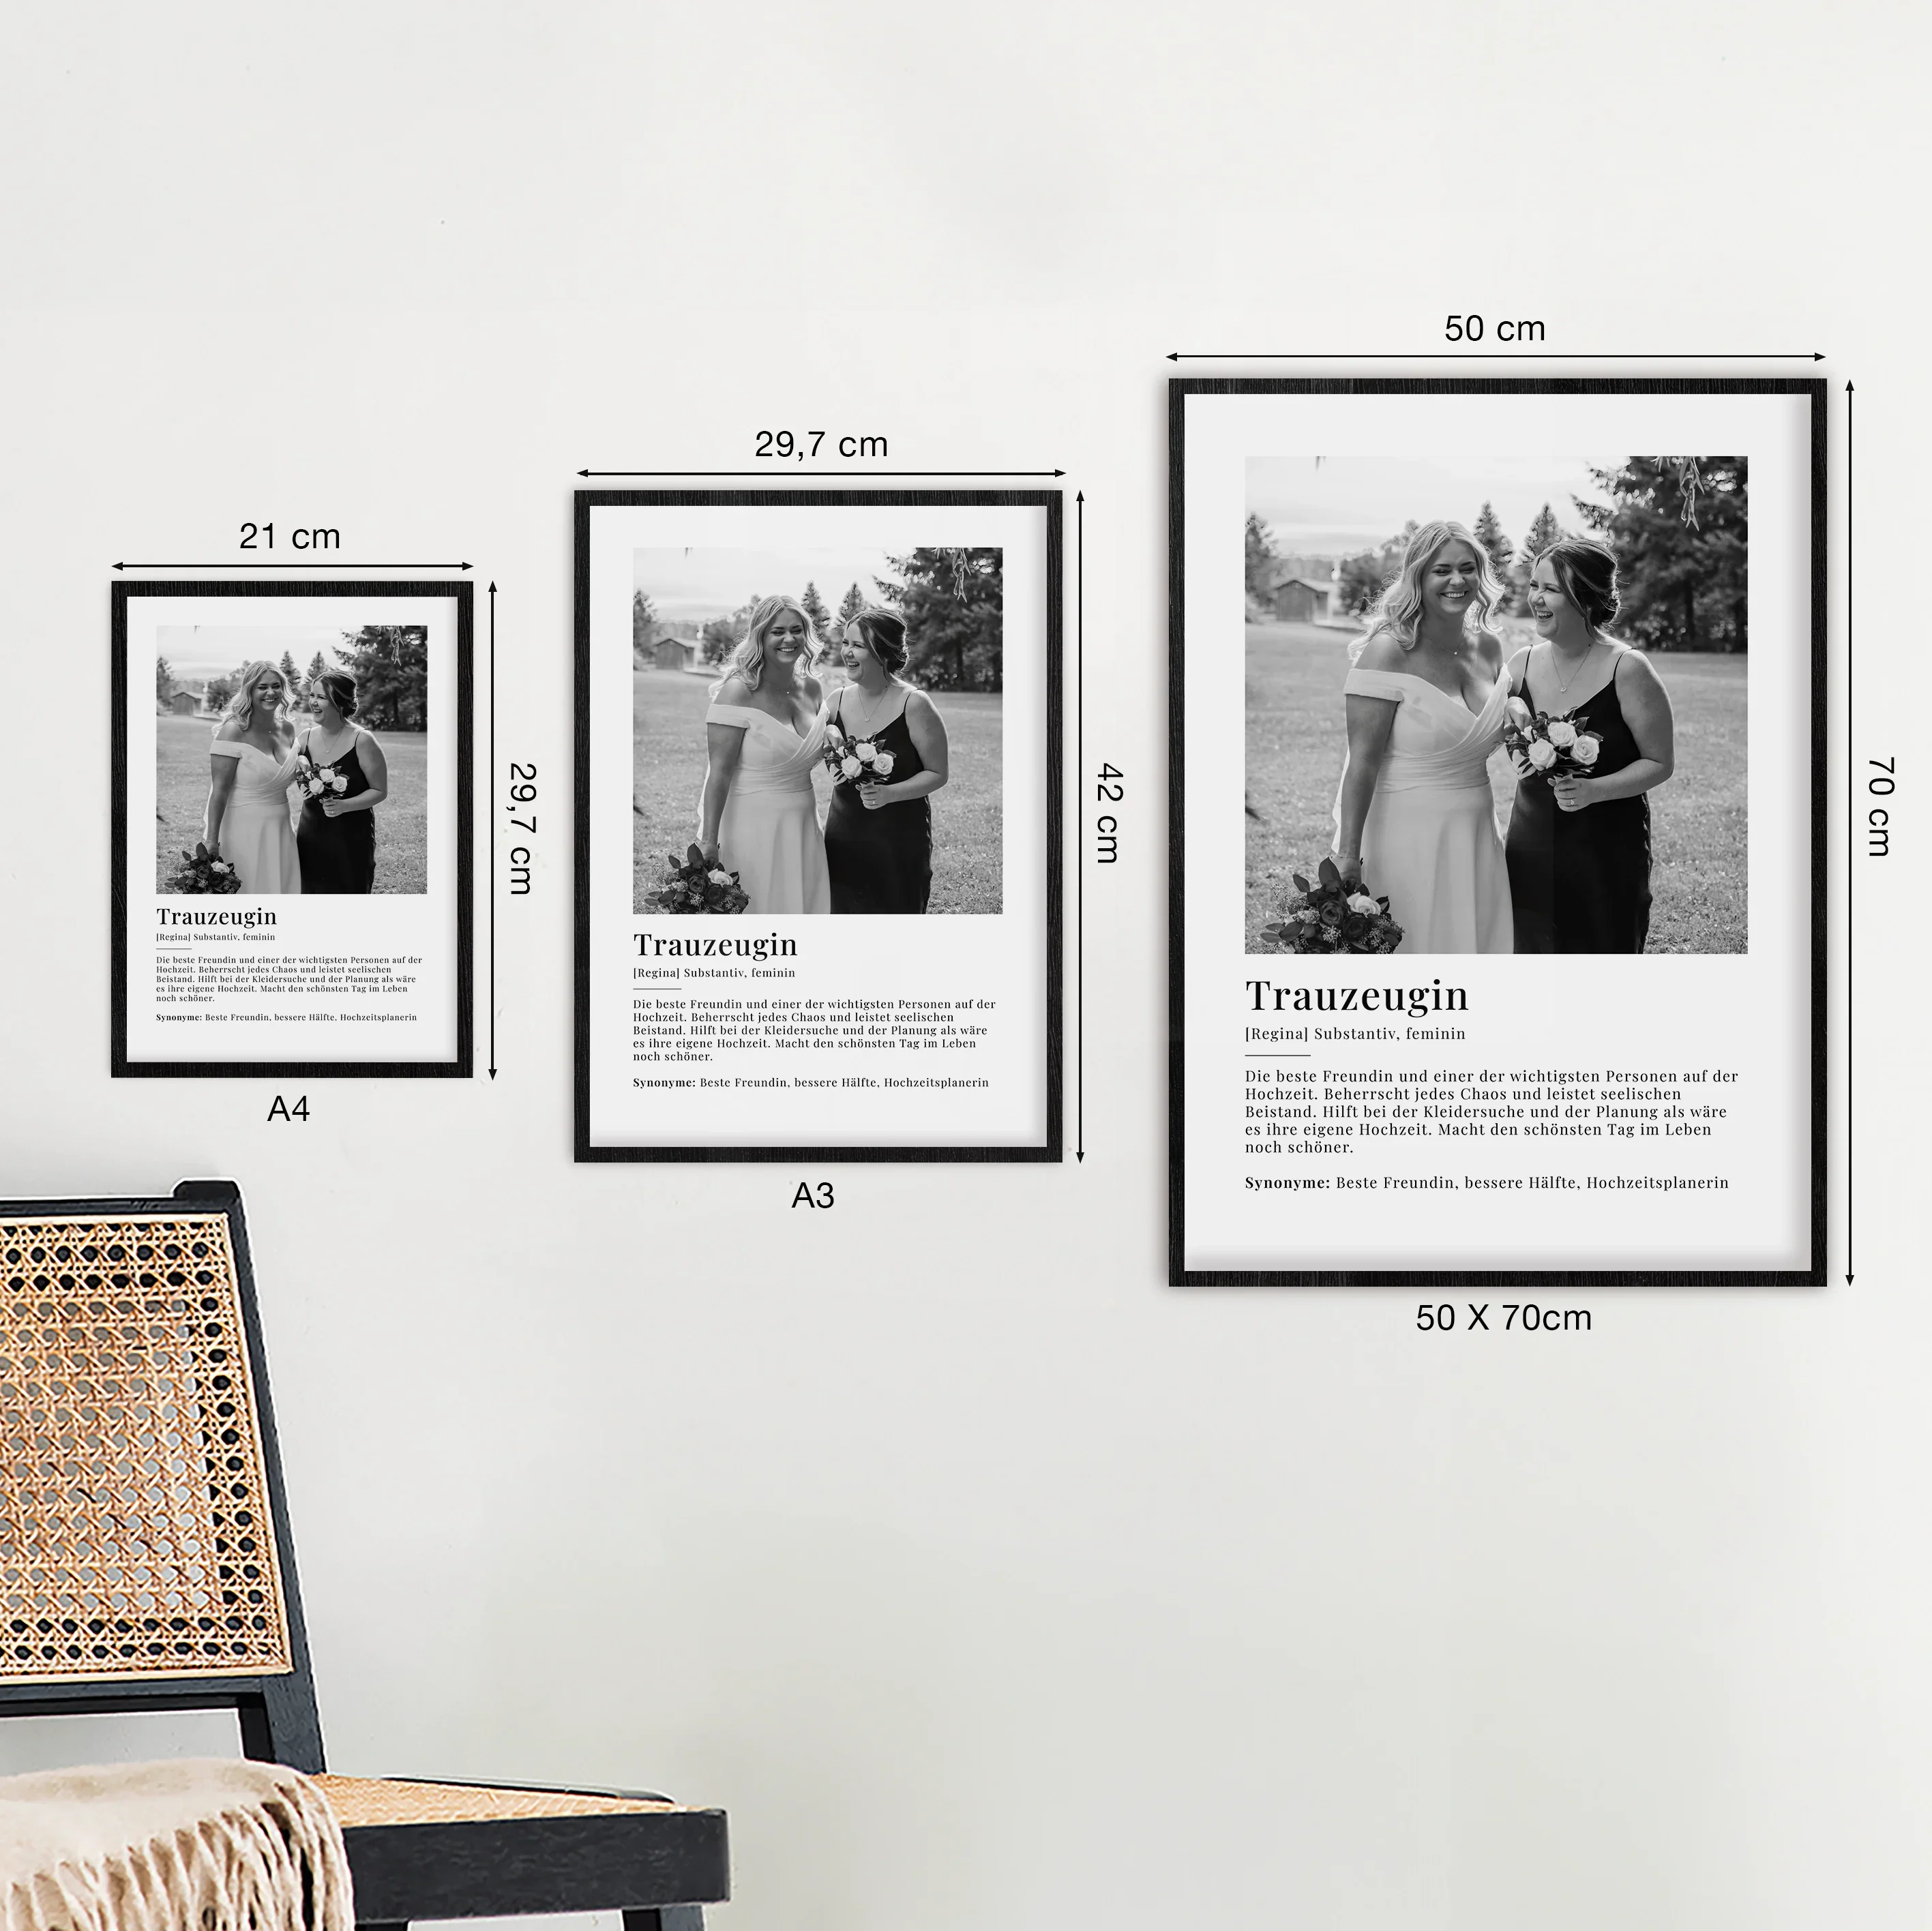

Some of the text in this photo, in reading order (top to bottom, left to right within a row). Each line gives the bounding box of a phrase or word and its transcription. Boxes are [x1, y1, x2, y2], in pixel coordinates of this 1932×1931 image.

[157, 908, 277, 929] Trauzeugin
[634, 933, 797, 961] Trauzeugin
[299, 957, 347, 965] wichtigsten
[634, 968, 794, 979] [Regina] Substantiv, feminin
[346, 976, 378, 984] Planung
[188, 985, 214, 993] eigene
[351, 985, 366, 993] Tag
[1246, 979, 1468, 1017] Trauzeugin
[634, 1000, 996, 1011] Die beste Freundin und einer der wichtigsten Personen auf der
[156, 1014, 202, 1022] Synonyme:
[341, 1014, 417, 1022] Hochzeitsplanerin
[634, 1013, 953, 1023] Hochzeit. Beherrscht jedes Chaos und leistet seelischen
[634, 1026, 987, 1036] Beistand. Hilft bei der Kleidersuche und der Planung als wäre
[1246, 1027, 1465, 1042] [Regina] Substantiv, feminin
[649, 1038, 671, 1048] ihre
[677, 1038, 712, 1049] eigene
[717, 1038, 770, 1048] Hochzeit.
[775, 1038, 809, 1048] Macht
[814, 1038, 833, 1048] den
[838, 1038, 895, 1048] schönsten
[900, 1039, 919, 1049] Tag
[924, 1038, 937, 1047] im
[942, 1038, 975, 1048] Leben
[634, 1051, 712, 1061] noch schöner.
[634, 1077, 988, 1089] Synonyme: Beste Freundin, bessere Hälfte, Hochzeitsplanerin
[1246, 1070, 1738, 1085] Die beste Freundin und einer der wichtigsten Personen auf der
[1246, 1088, 1681, 1102] Hochzeit. Beherrscht jedes Chaos und leistet seelischen
[1246, 1105, 1726, 1120] Beistand. Hilft bei der Kleidersuche und der Planung als wäre
[1245, 1123, 1711, 1138] es ihre eigene Hochzeit. Macht den schönsten Tag im Leben
[1246, 1141, 1352, 1153] noch schöner.
[1246, 1176, 1728, 1191] Synonyme: Beste Freundin, bessere Hälfte, Hochzeitsplanerin
